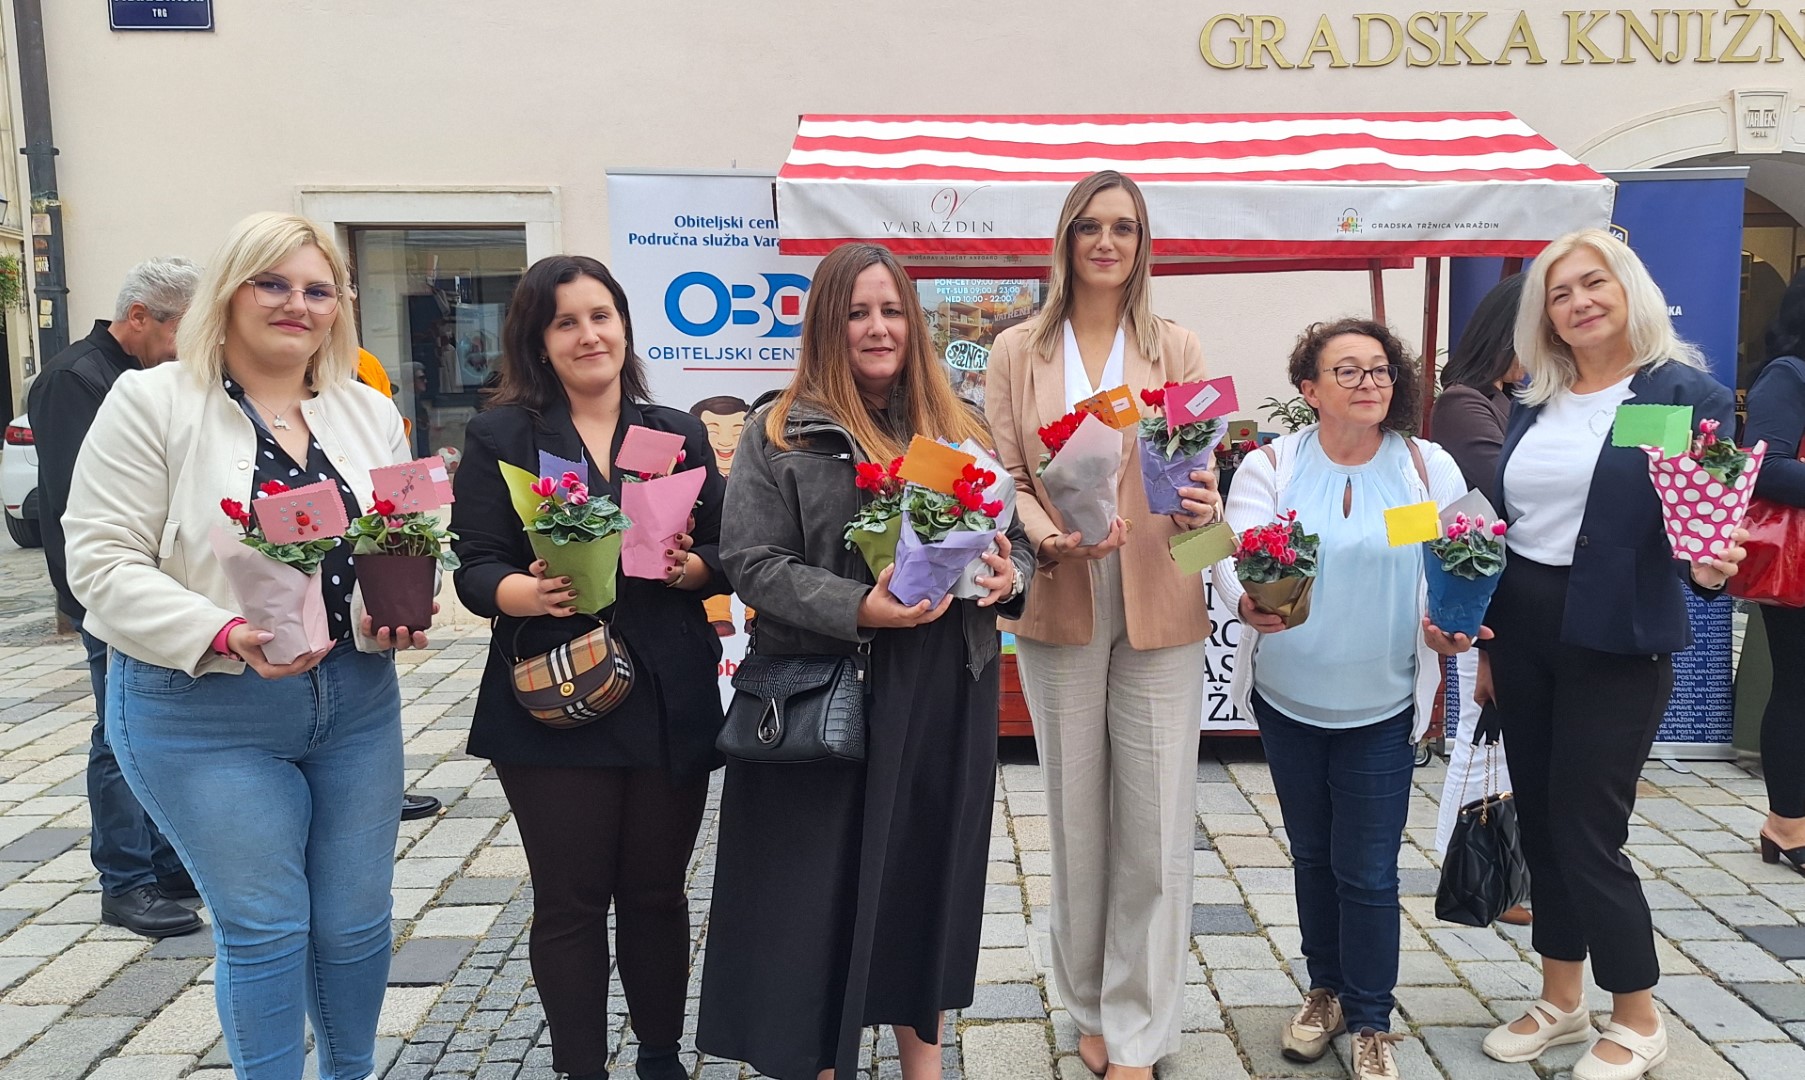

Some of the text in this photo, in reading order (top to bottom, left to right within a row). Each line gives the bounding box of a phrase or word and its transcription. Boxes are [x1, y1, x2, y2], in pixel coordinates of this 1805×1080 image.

[152, 8, 168, 17] TRG
[1198, 10, 1547, 69] GRADSKA
[674, 215, 743, 231] Obiteljski
[1417, 221, 1451, 229] TRŽNICA
[1454, 221, 1499, 229] VARAŽDIN
[628, 232, 698, 246] Područna
[702, 233, 749, 247] služba
[648, 346, 752, 360] OBITELJSKI
